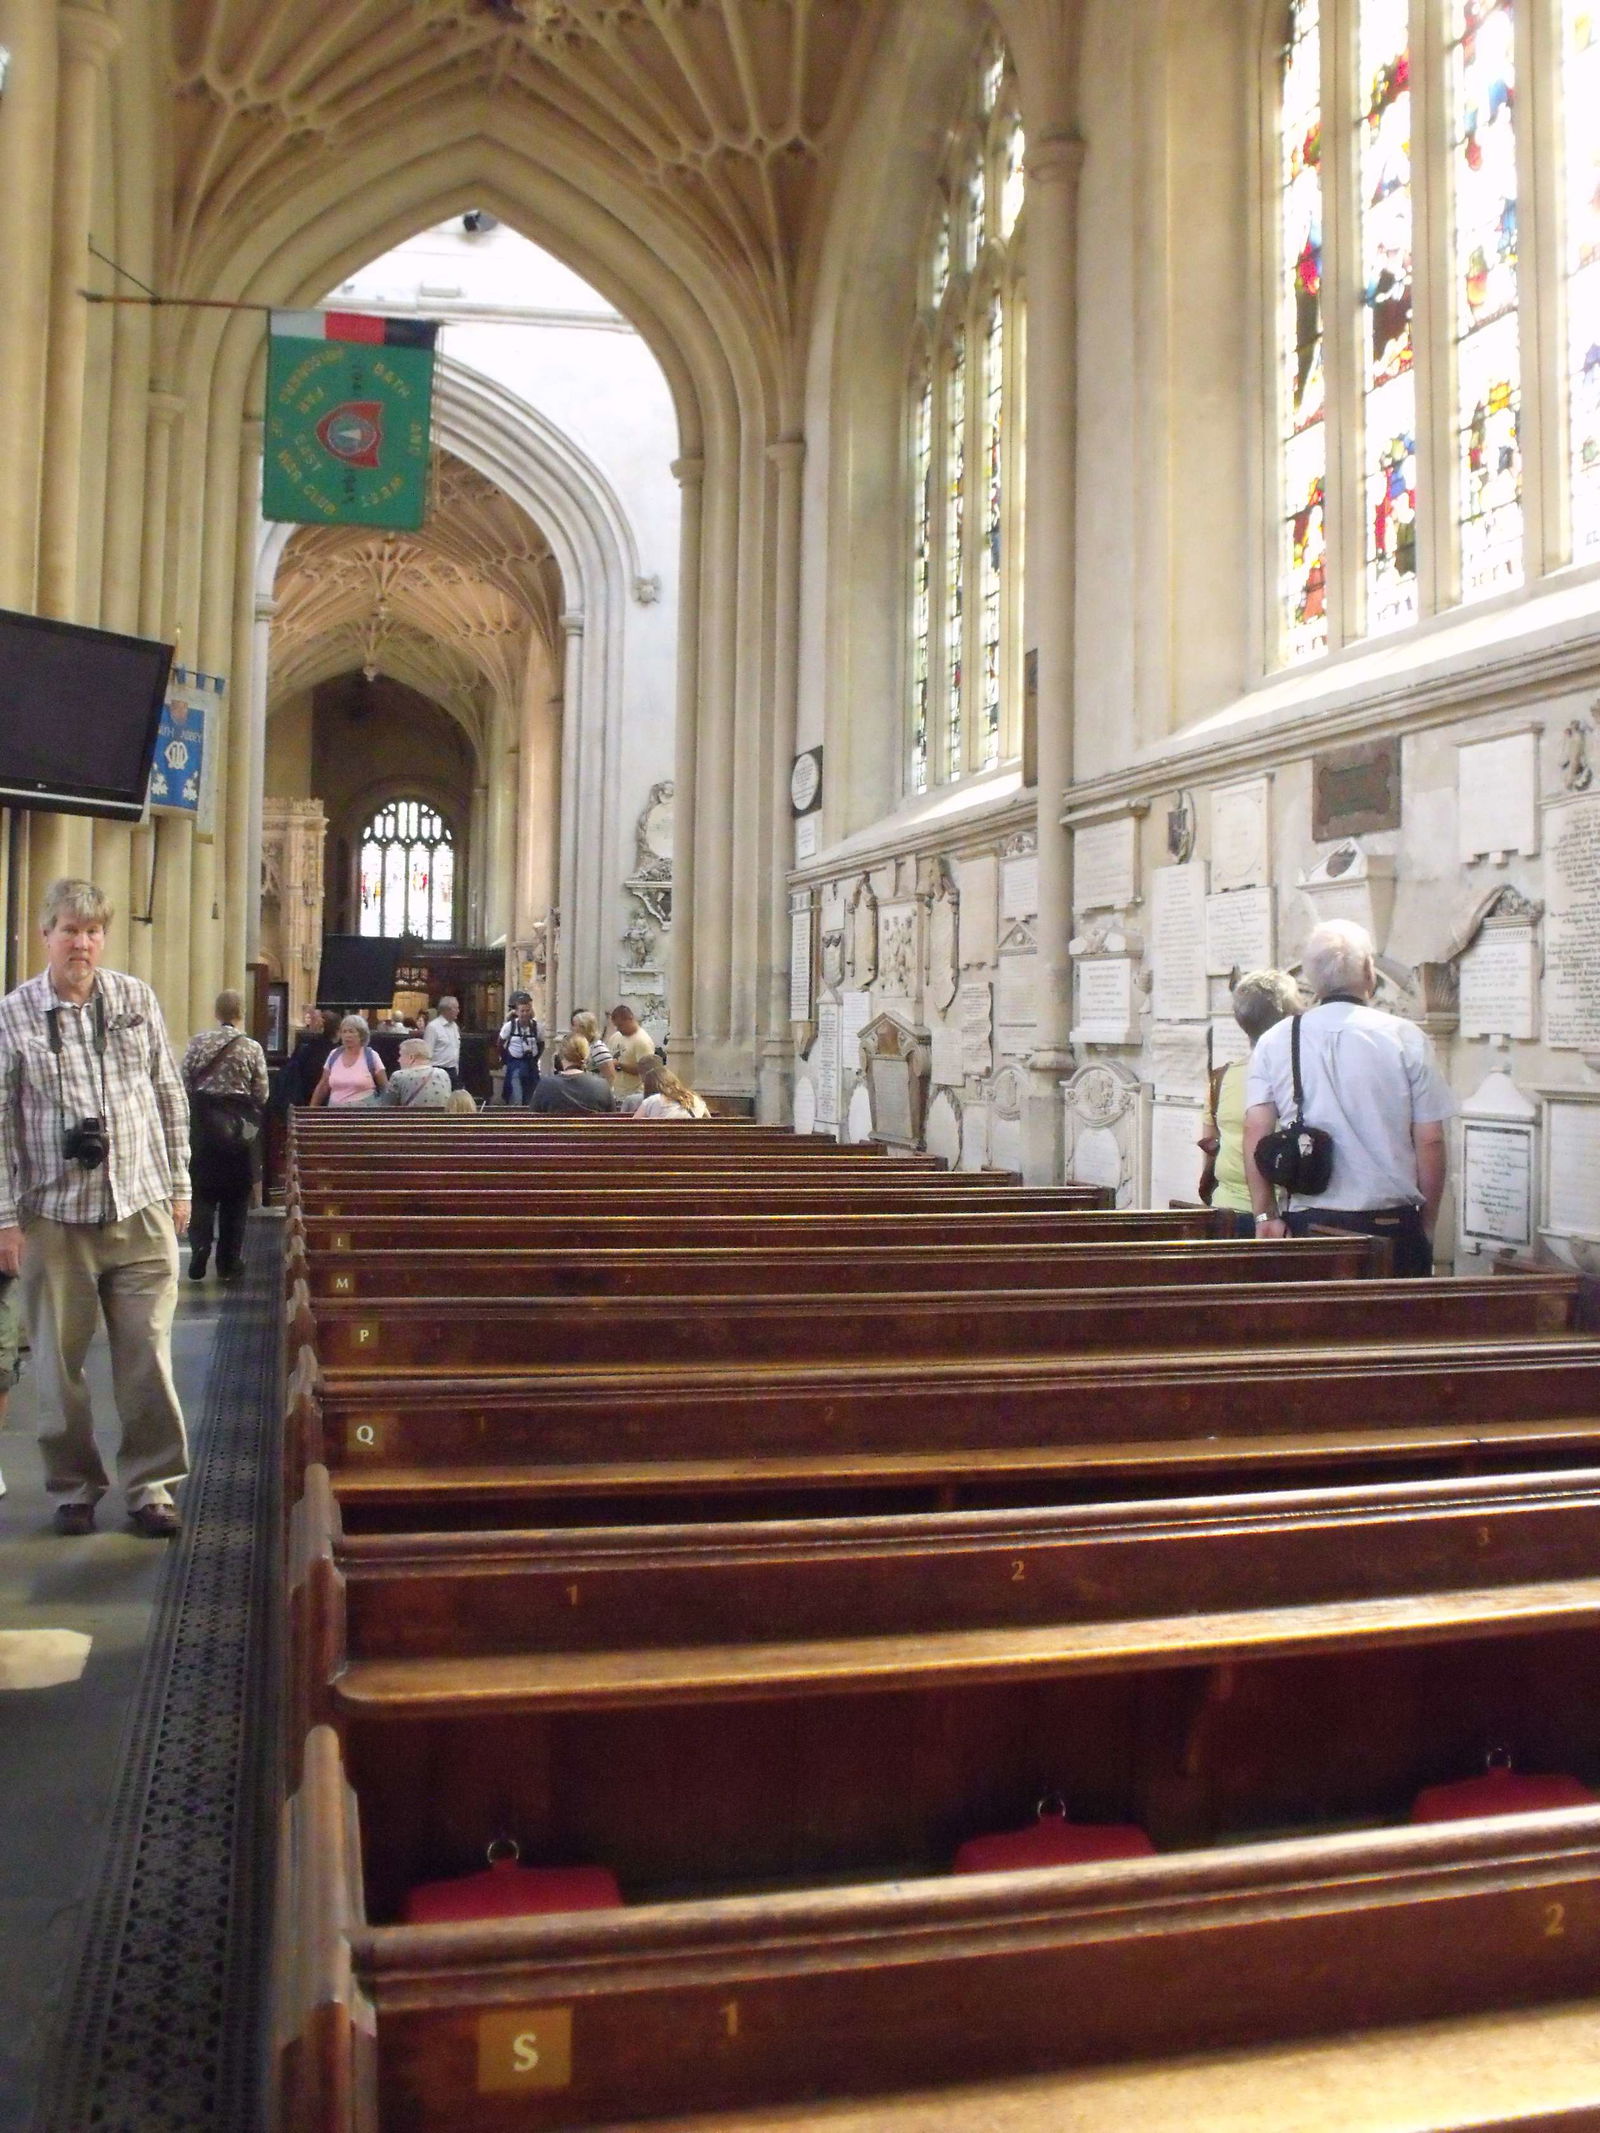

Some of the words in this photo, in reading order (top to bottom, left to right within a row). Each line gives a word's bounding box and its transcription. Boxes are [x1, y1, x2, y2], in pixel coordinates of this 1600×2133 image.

[336, 1237, 344, 1248] L
[335, 1278, 350, 1290] M
[359, 1329, 370, 1343] P
[356, 1425, 375, 1446] Q
[1010, 1560, 1025, 1581] 2
[565, 1584, 578, 1606] 1
[1544, 1902, 1565, 1937] 2
[718, 2001, 740, 2037] 1
[513, 2032, 540, 2073] S
